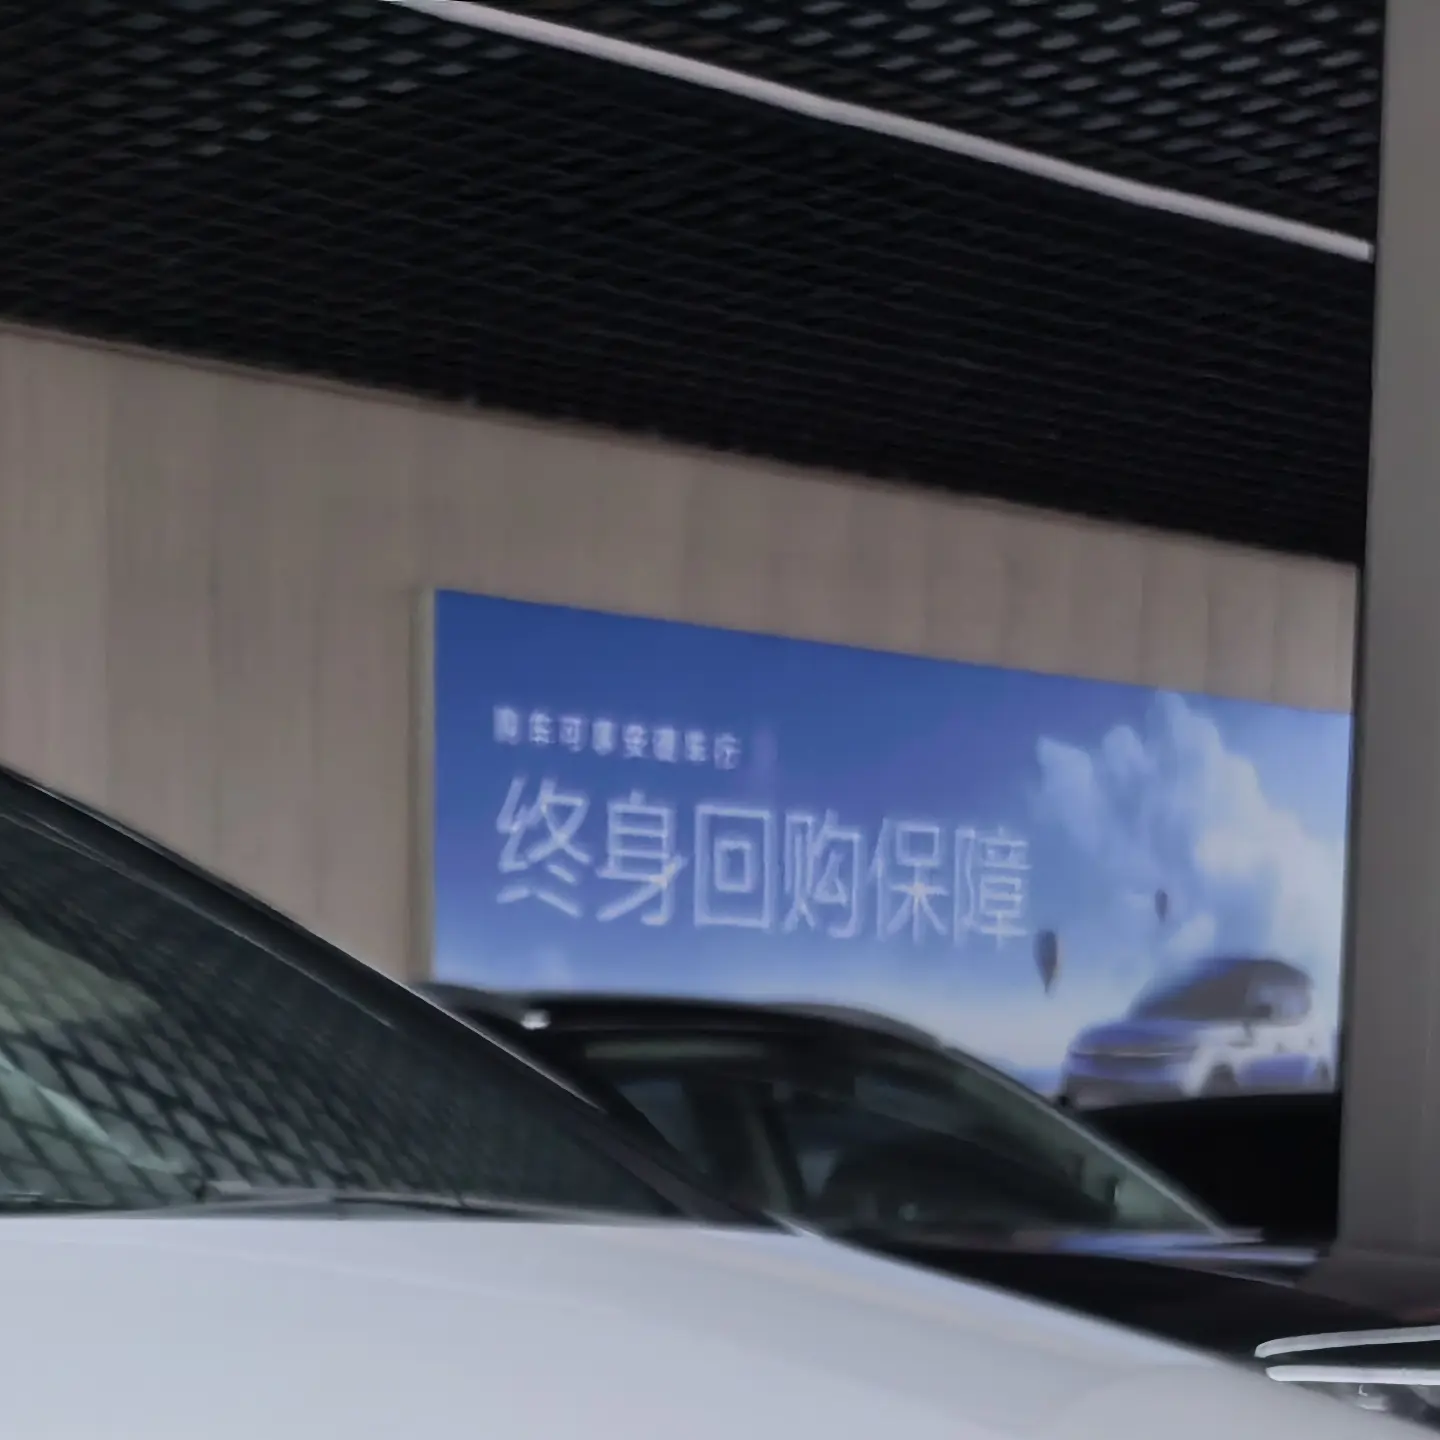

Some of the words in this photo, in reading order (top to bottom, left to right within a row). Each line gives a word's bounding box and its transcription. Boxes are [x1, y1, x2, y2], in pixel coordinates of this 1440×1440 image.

[493, 774, 1032, 949] 终身回购保障
